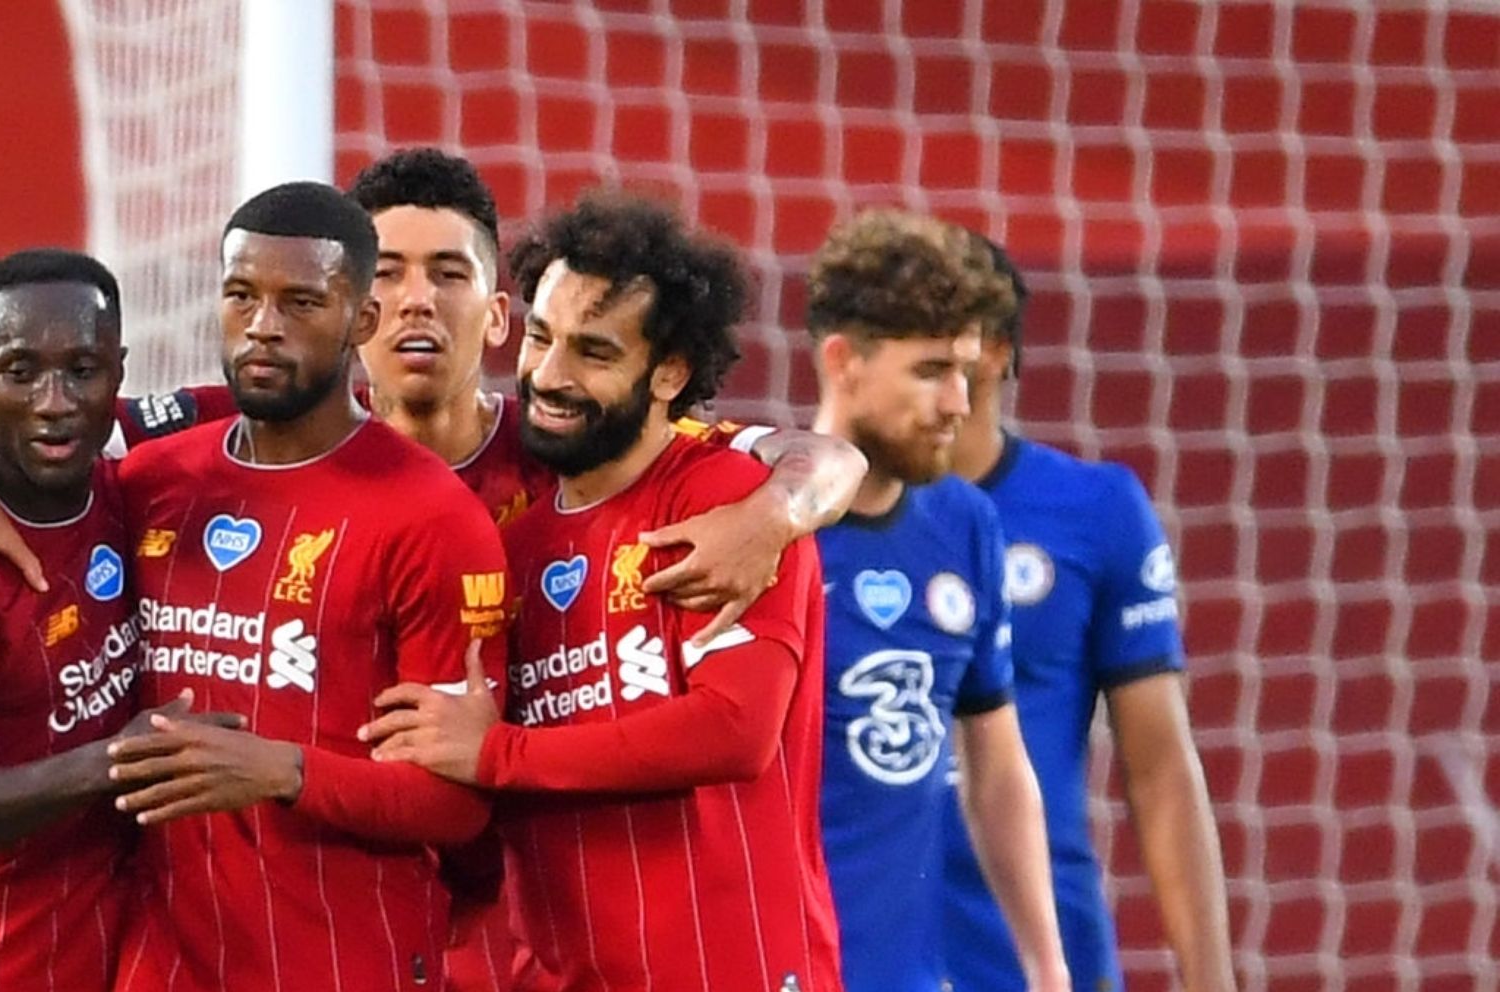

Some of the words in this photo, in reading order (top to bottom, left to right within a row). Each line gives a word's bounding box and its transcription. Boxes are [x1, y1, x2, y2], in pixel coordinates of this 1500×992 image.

[212, 531, 249, 550] NHS
[88, 563, 115, 588] NHS
[273, 584, 313, 604] LFC
[138, 597, 266, 645] Standard
[608, 593, 647, 614] LFC
[59, 614, 140, 697] Standar
[520, 631, 608, 689] andard
[49, 660, 138, 732] Charte
[521, 671, 613, 727] artered
[838, 649, 947, 785] 3
